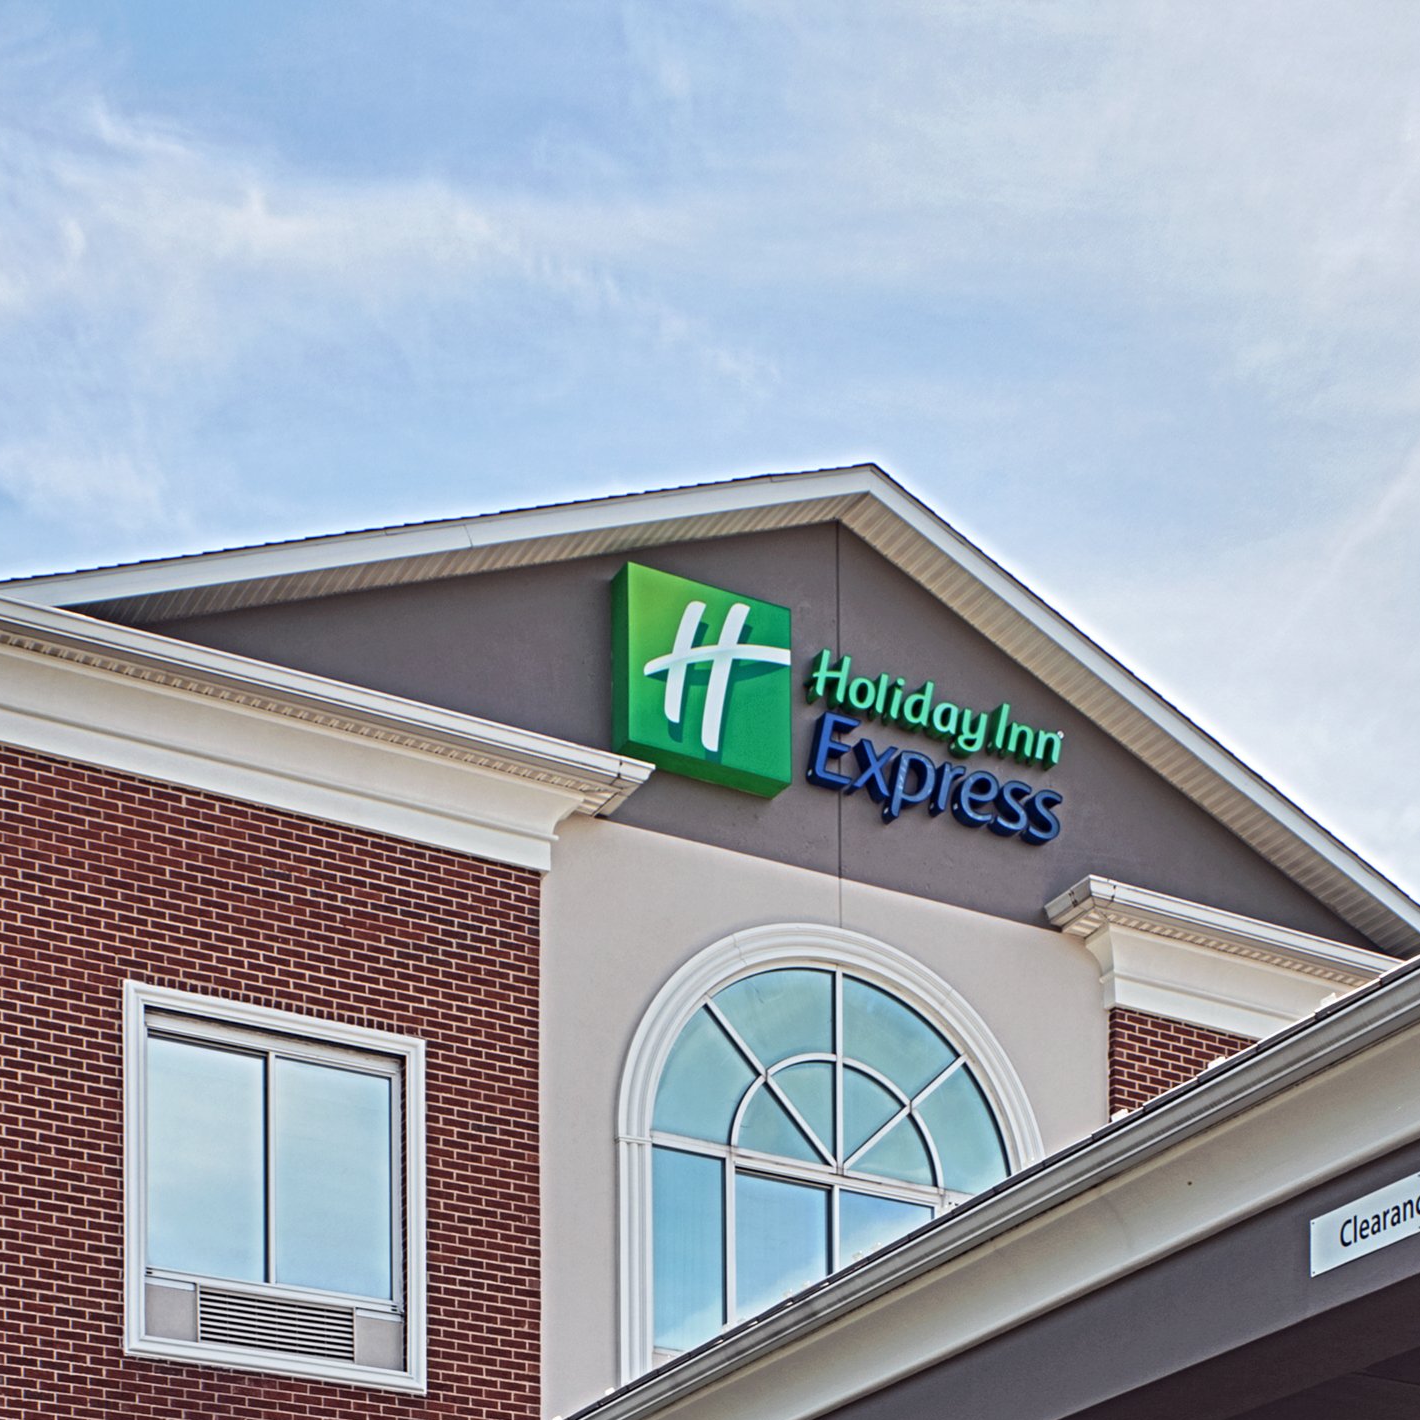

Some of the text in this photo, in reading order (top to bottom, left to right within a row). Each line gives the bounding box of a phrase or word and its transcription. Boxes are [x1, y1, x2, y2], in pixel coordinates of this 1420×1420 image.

[807, 647, 1064, 770] Holiday Inn
[806, 711, 1064, 846] Express
